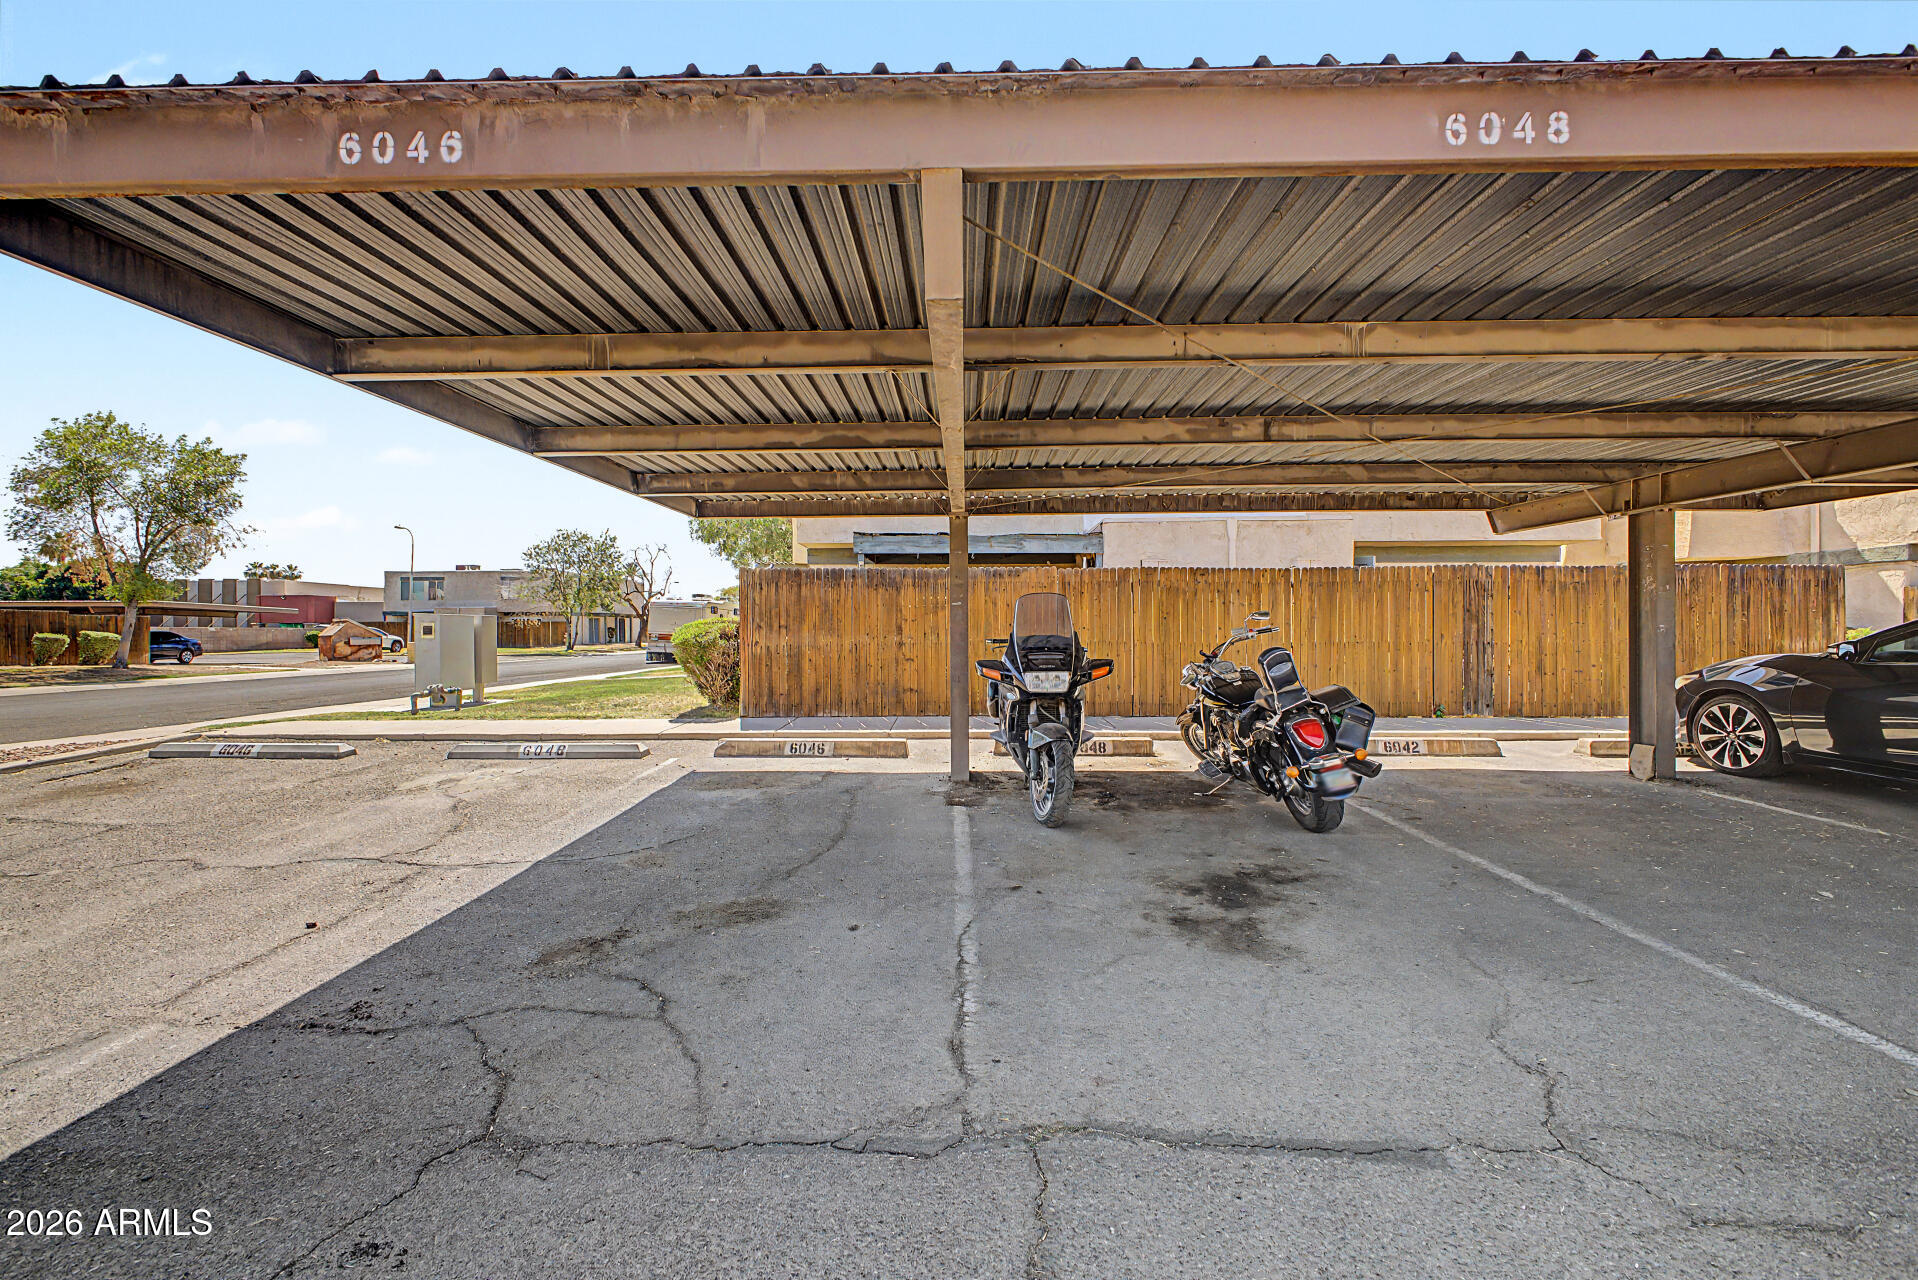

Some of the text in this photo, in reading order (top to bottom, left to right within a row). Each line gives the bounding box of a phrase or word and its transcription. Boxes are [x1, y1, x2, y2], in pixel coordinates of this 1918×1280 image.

[1445, 111, 1570, 145] 6048
[339, 130, 463, 165] 6046
[789, 742, 826, 755] 6046
[1080, 741, 1107, 754] 048
[1383, 740, 1420, 754] 6042
